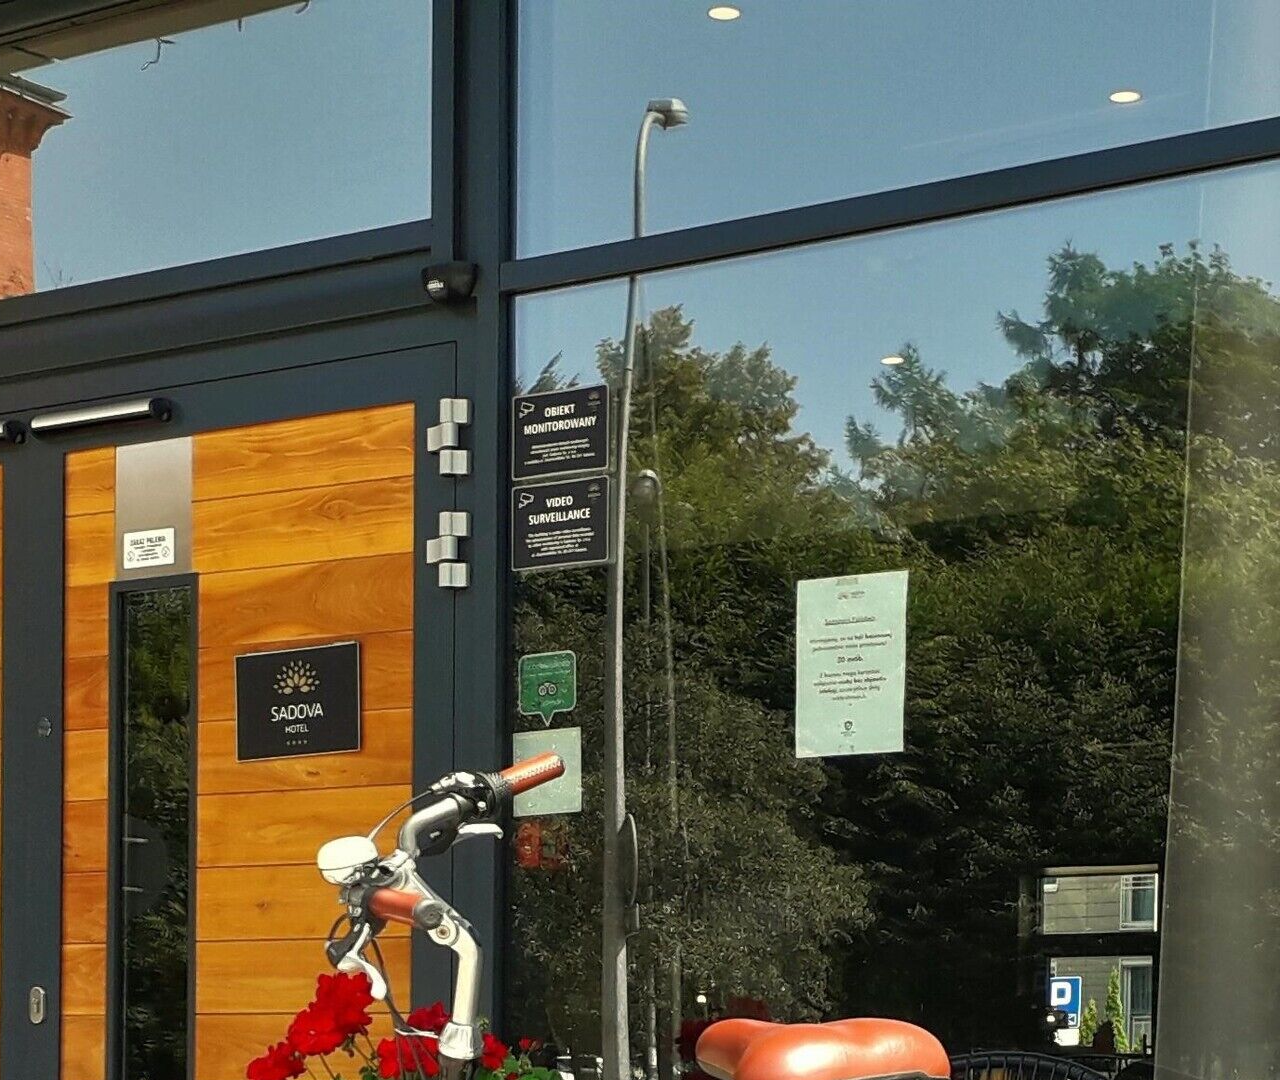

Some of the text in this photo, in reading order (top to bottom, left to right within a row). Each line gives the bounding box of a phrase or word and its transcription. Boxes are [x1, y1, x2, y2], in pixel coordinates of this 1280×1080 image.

[544, 403, 576, 418] OBIEKT
[523, 416, 597, 435] MONITOROWANY
[546, 495, 574, 508] VIDEO
[528, 507, 591, 526] SURVEILLANCE
[271, 702, 324, 722] SADOVA
[285, 723, 310, 734] HOTEL
